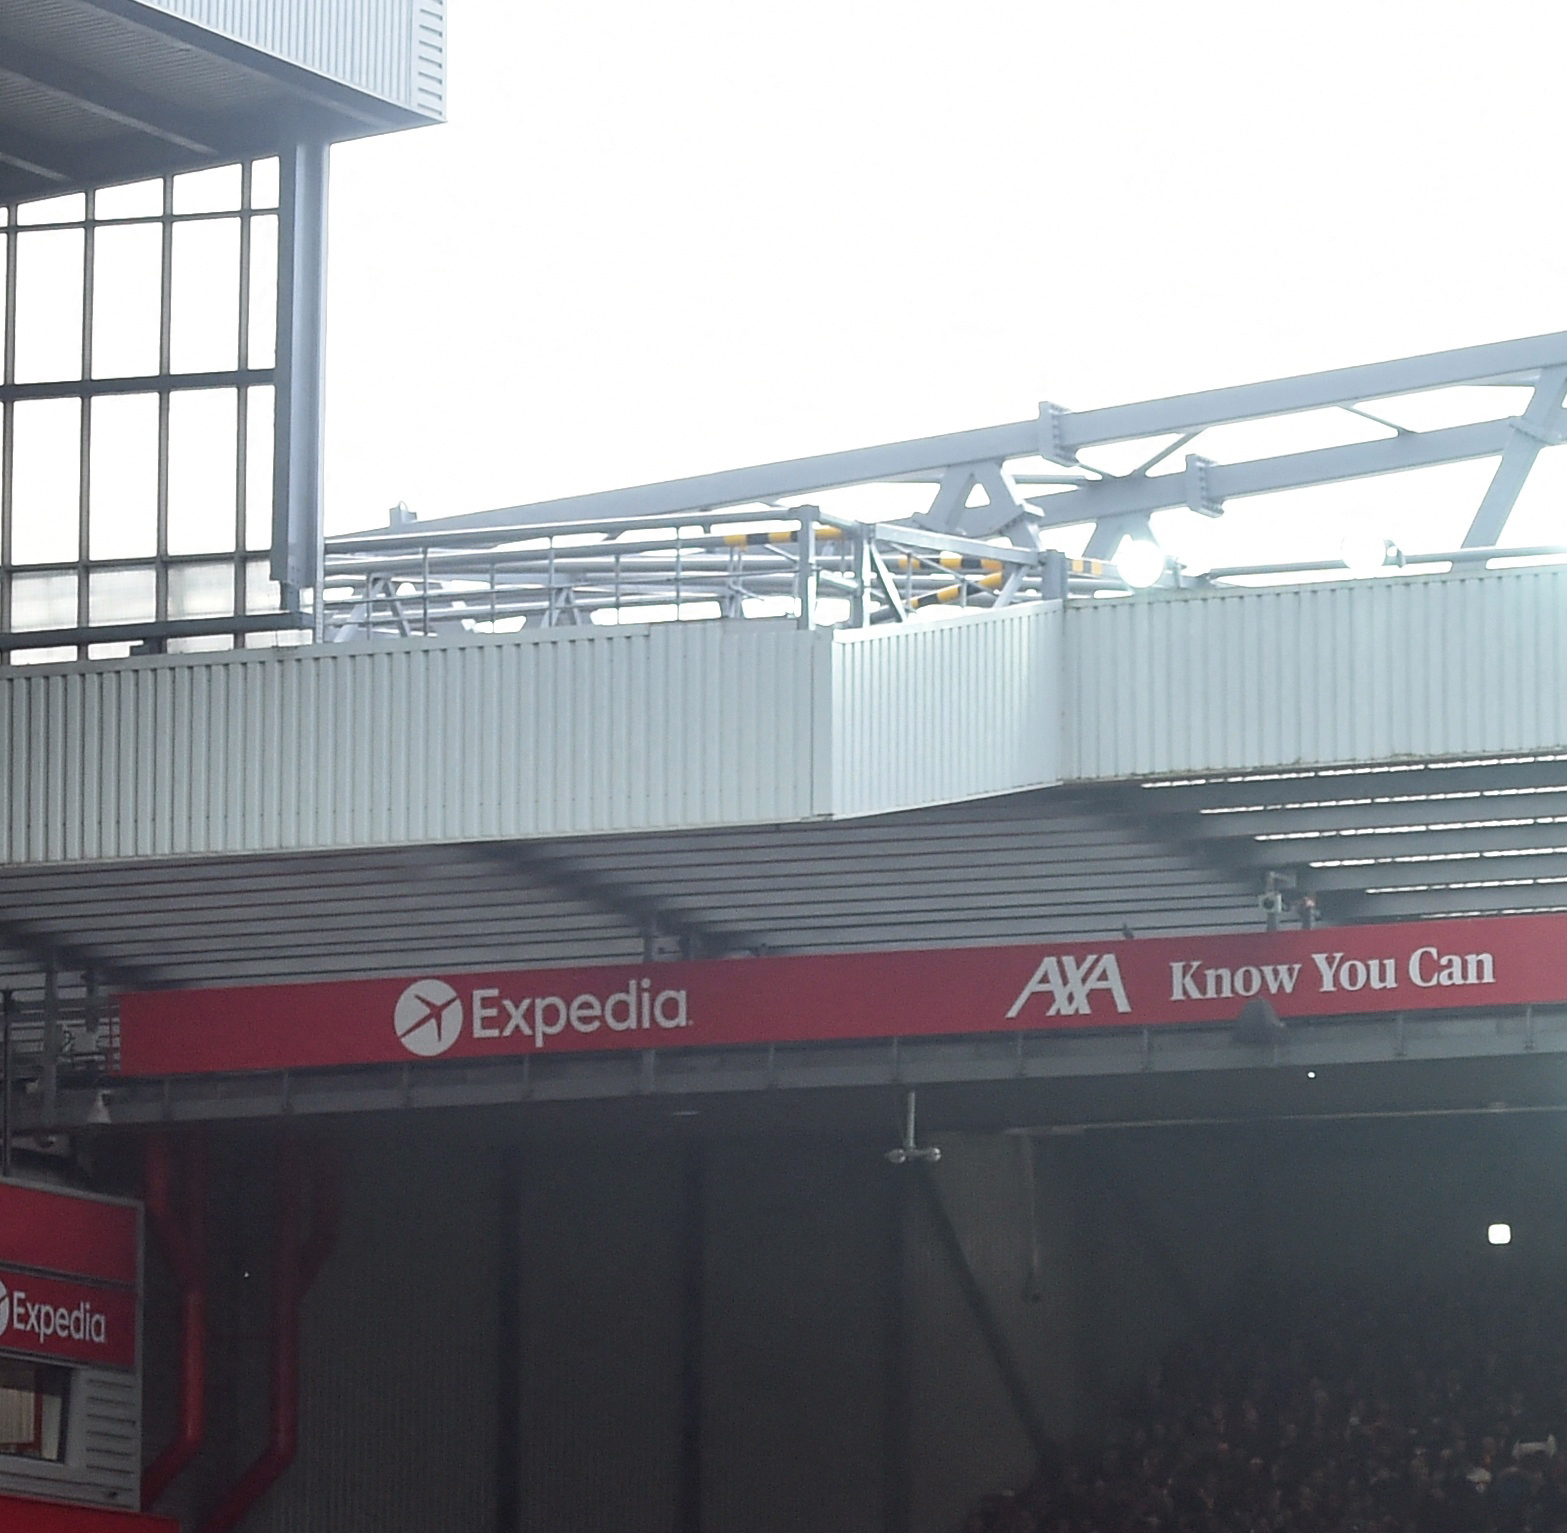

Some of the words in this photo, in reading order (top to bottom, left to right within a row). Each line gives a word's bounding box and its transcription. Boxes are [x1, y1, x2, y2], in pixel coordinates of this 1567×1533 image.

[1005, 953, 1132, 1018] AXA
[1169, 961, 1302, 1001] Know
[1312, 952, 1399, 992] You
[1409, 947, 1496, 988] Can
[472, 977, 688, 1048] Expedia
[12, 1290, 106, 1344] Expedia
